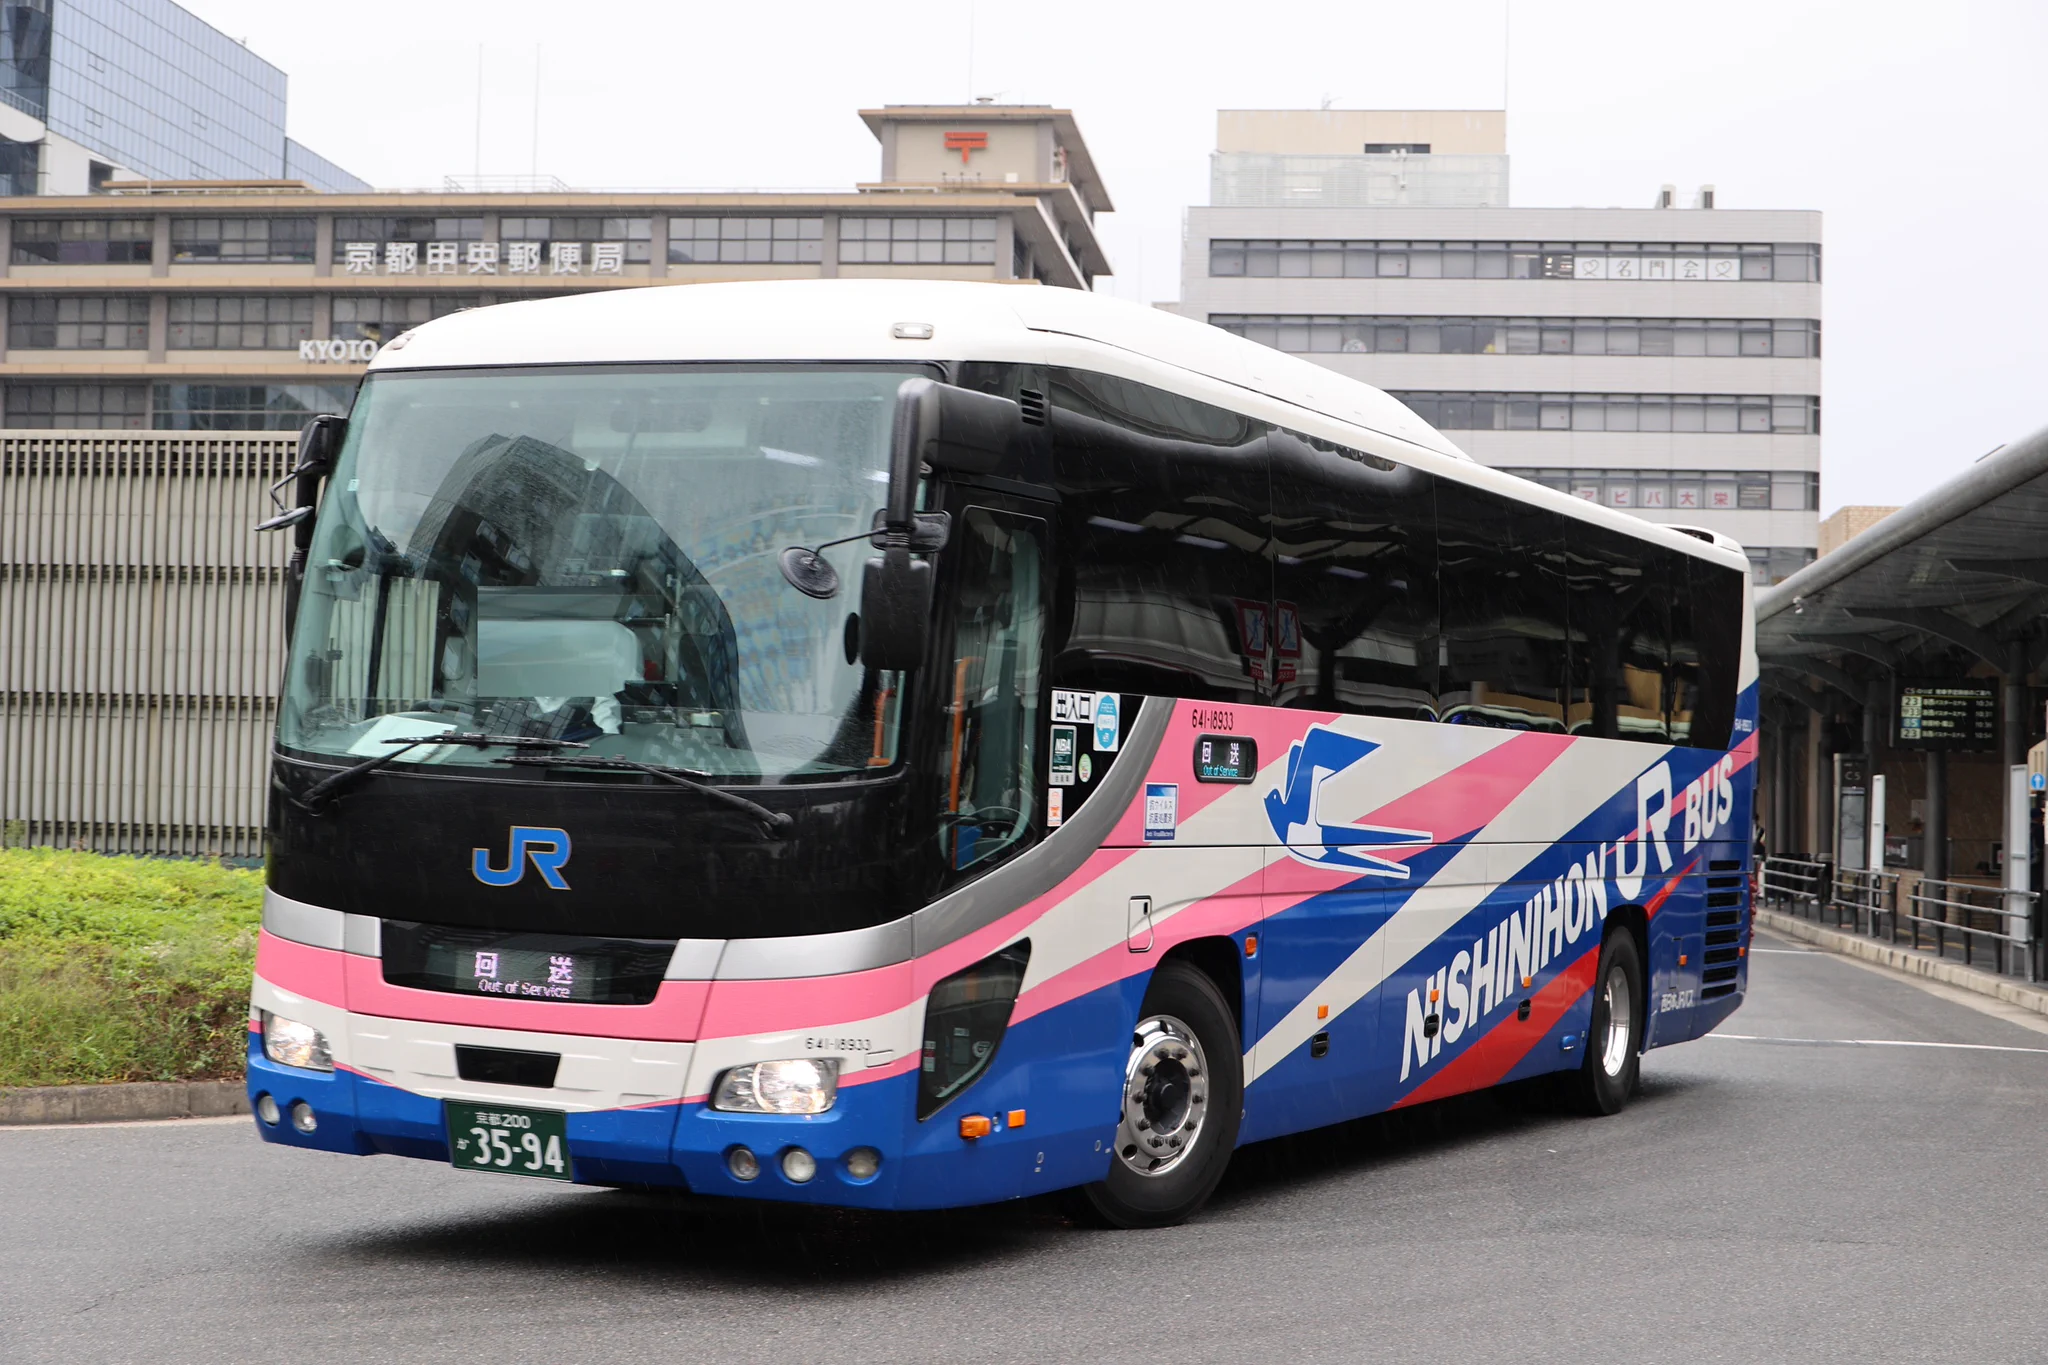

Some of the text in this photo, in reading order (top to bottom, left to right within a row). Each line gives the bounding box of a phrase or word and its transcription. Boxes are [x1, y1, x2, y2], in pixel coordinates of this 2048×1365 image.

[345, 242, 622, 274] 京都中央郵便局
[299, 339, 379, 361] KYOTO
[1055, 693, 1091, 720] 出入口
[1203, 765, 1213, 776] Out
[1219, 766, 1239, 777] Service
[472, 825, 572, 890] JR
[1400, 753, 1733, 1083] NISHINIHON JR BUS
[478, 979, 571, 998] Out of Service
[469, 1127, 565, 1173] 35-94
